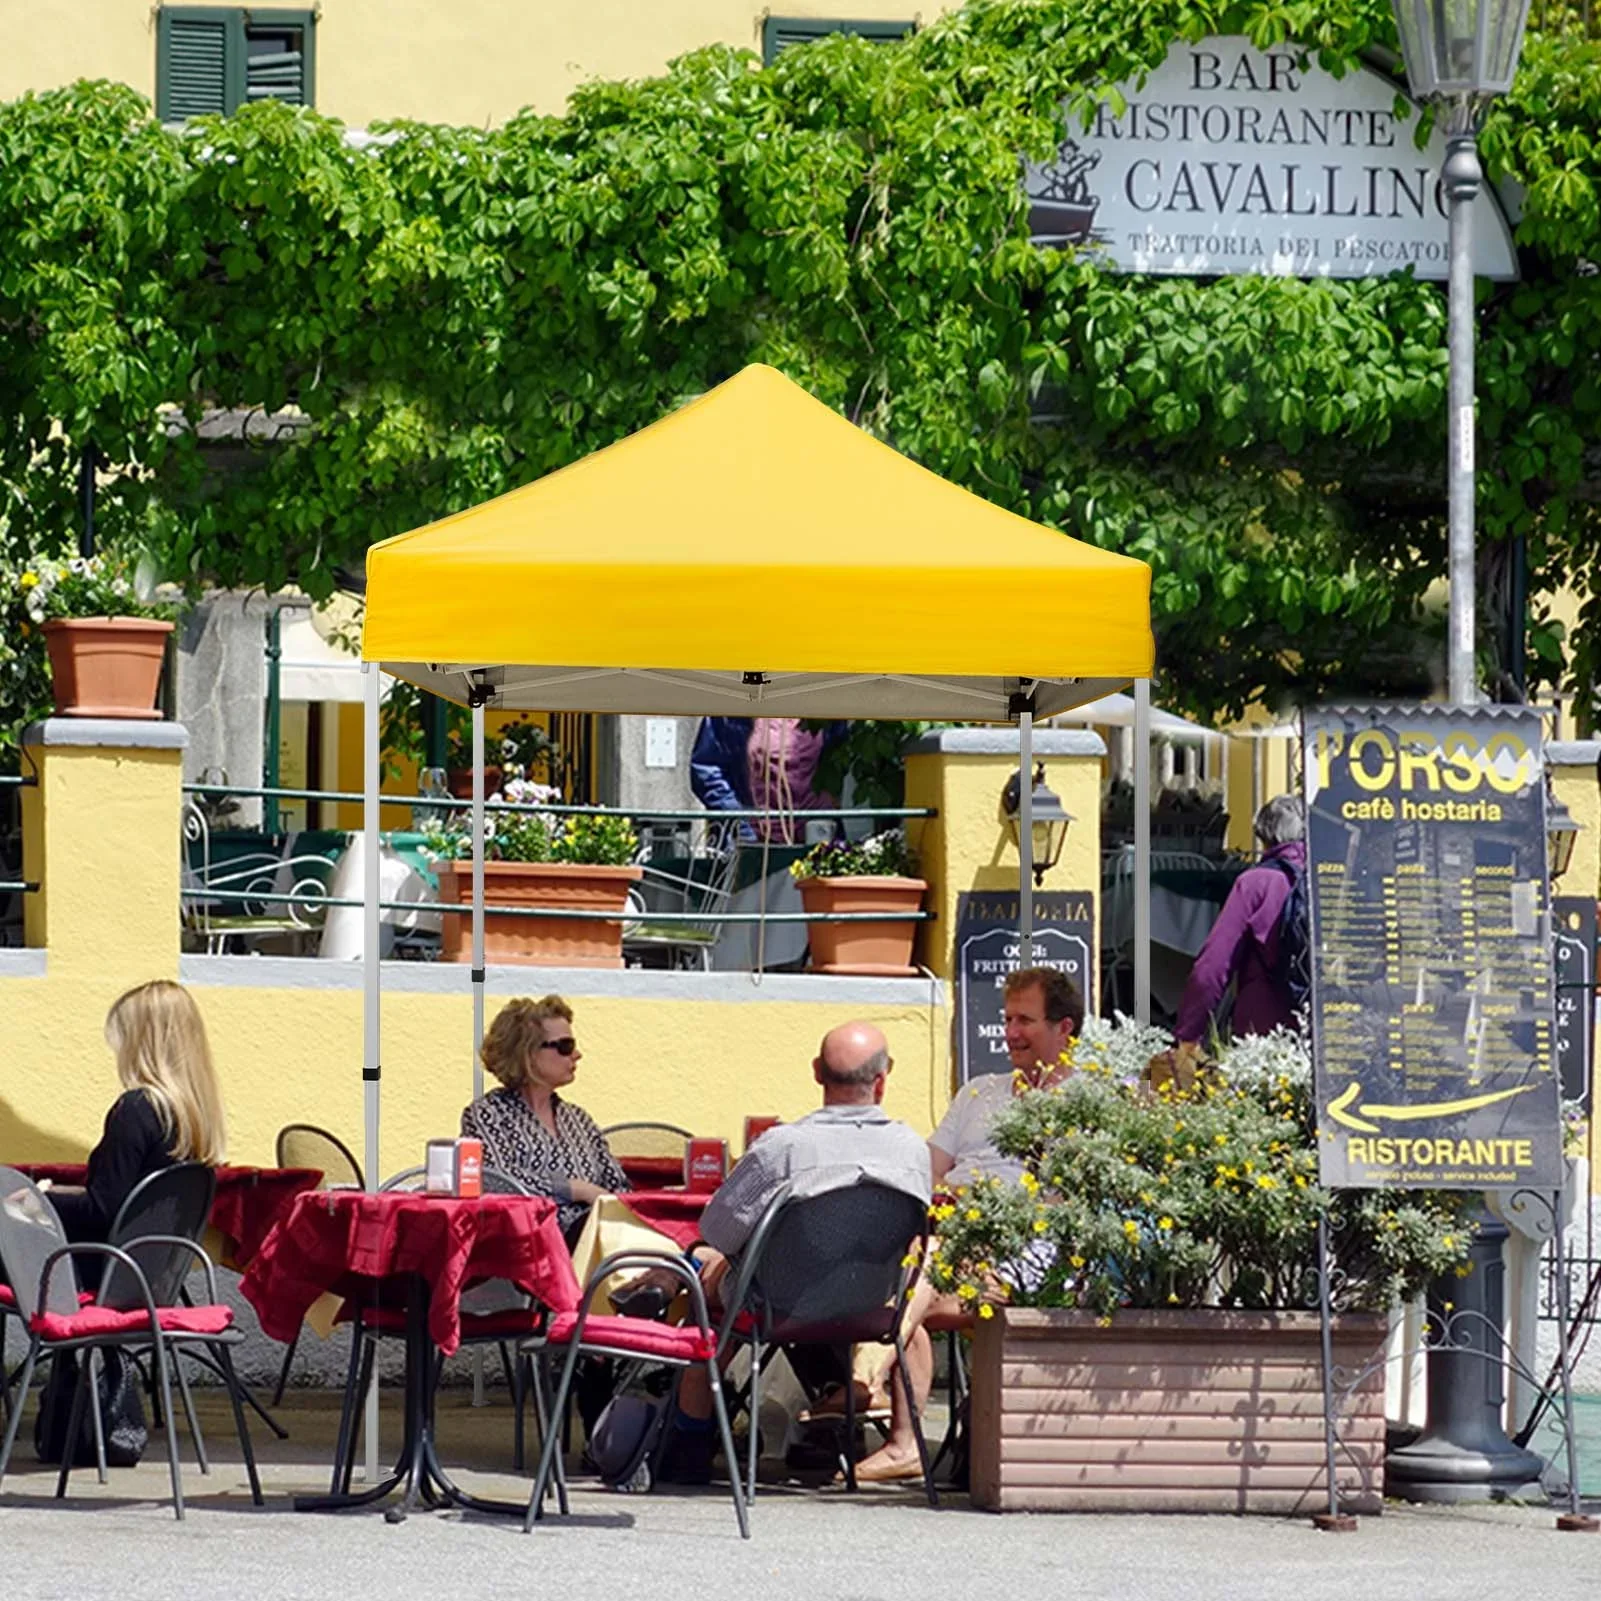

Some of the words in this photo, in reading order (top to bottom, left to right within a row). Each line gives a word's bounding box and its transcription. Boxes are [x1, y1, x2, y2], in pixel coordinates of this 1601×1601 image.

[1189, 51, 1300, 92] BAR
[1094, 102, 1395, 148] RISTORANTE
[1127, 233, 1264, 257] TRATTORIA
[1279, 236, 1320, 259] DEI
[1333, 239, 1449, 262] PESCATO
[1341, 797, 1395, 821] cafè
[1401, 799, 1502, 822] hostaria
[1347, 1137, 1534, 1168] RISTORANTE
